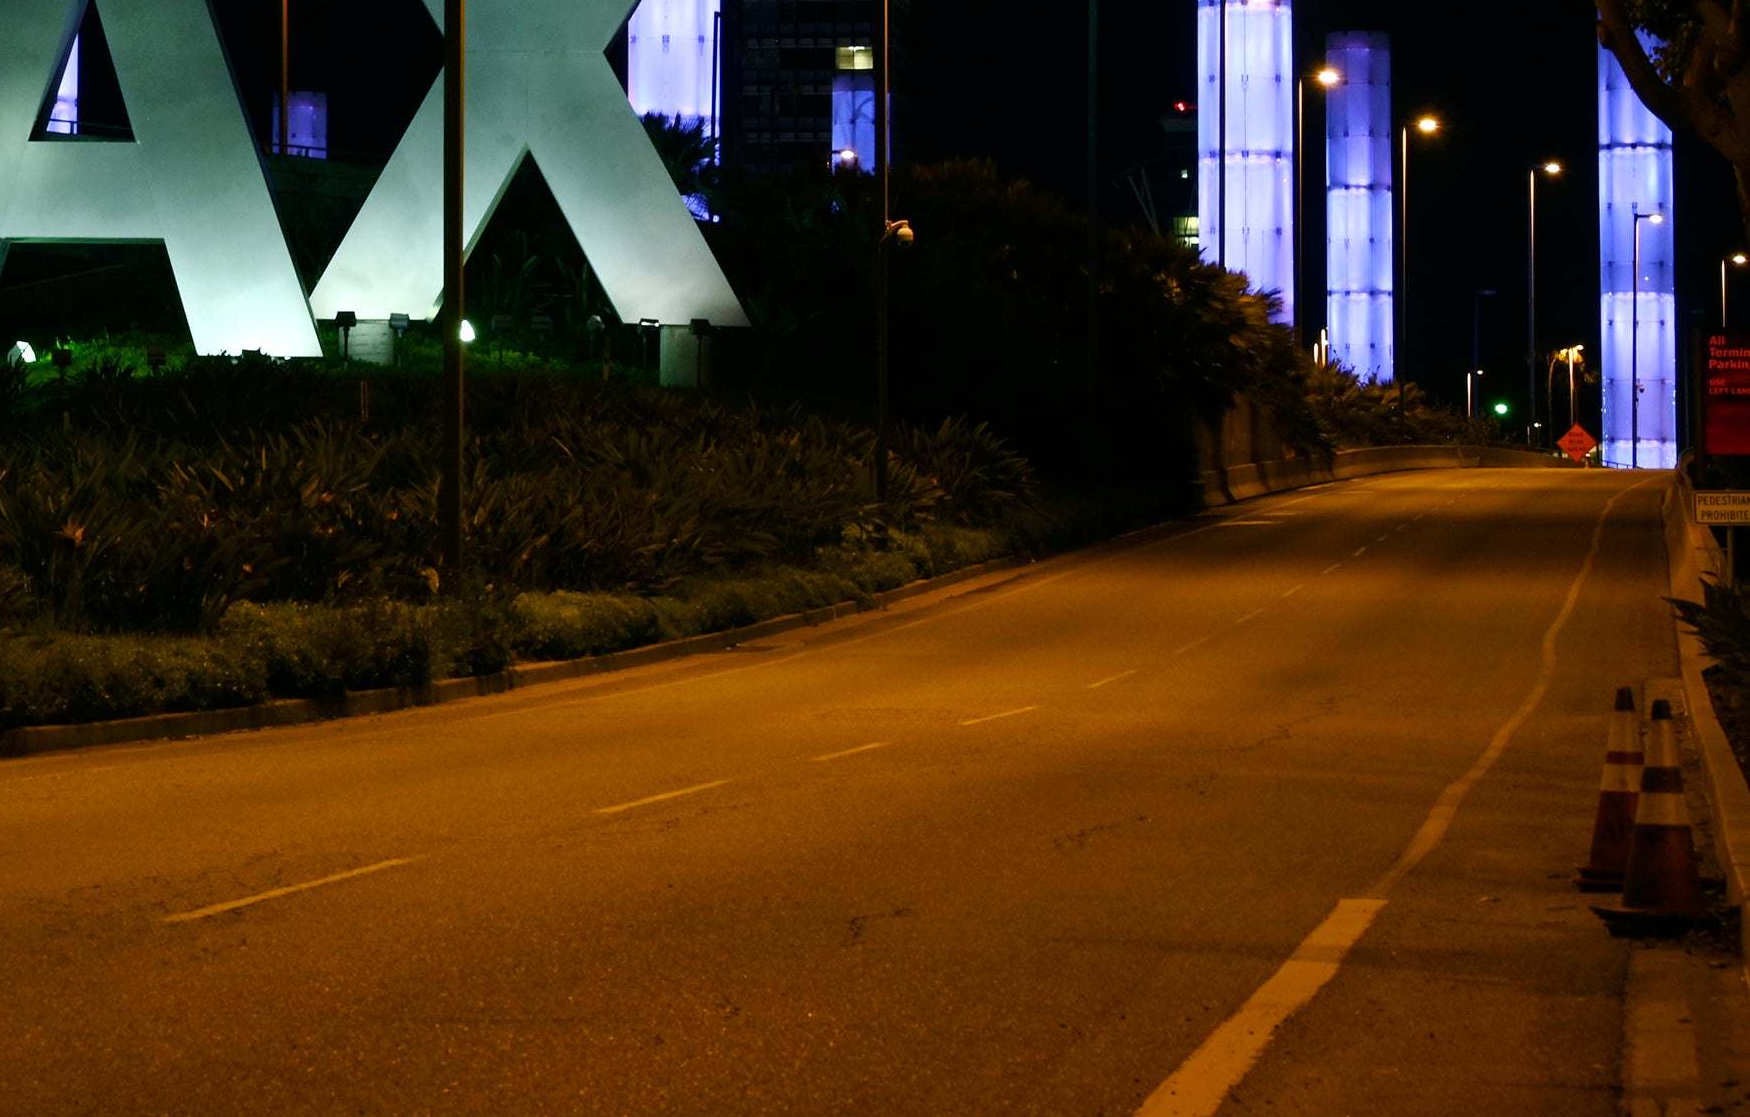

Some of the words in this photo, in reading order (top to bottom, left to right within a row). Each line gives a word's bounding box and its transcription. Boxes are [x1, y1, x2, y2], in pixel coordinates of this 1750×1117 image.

[1709, 335, 1726, 346] All
[1709, 358, 1750, 371] Parkin
[1709, 387, 1729, 395] LEFT
